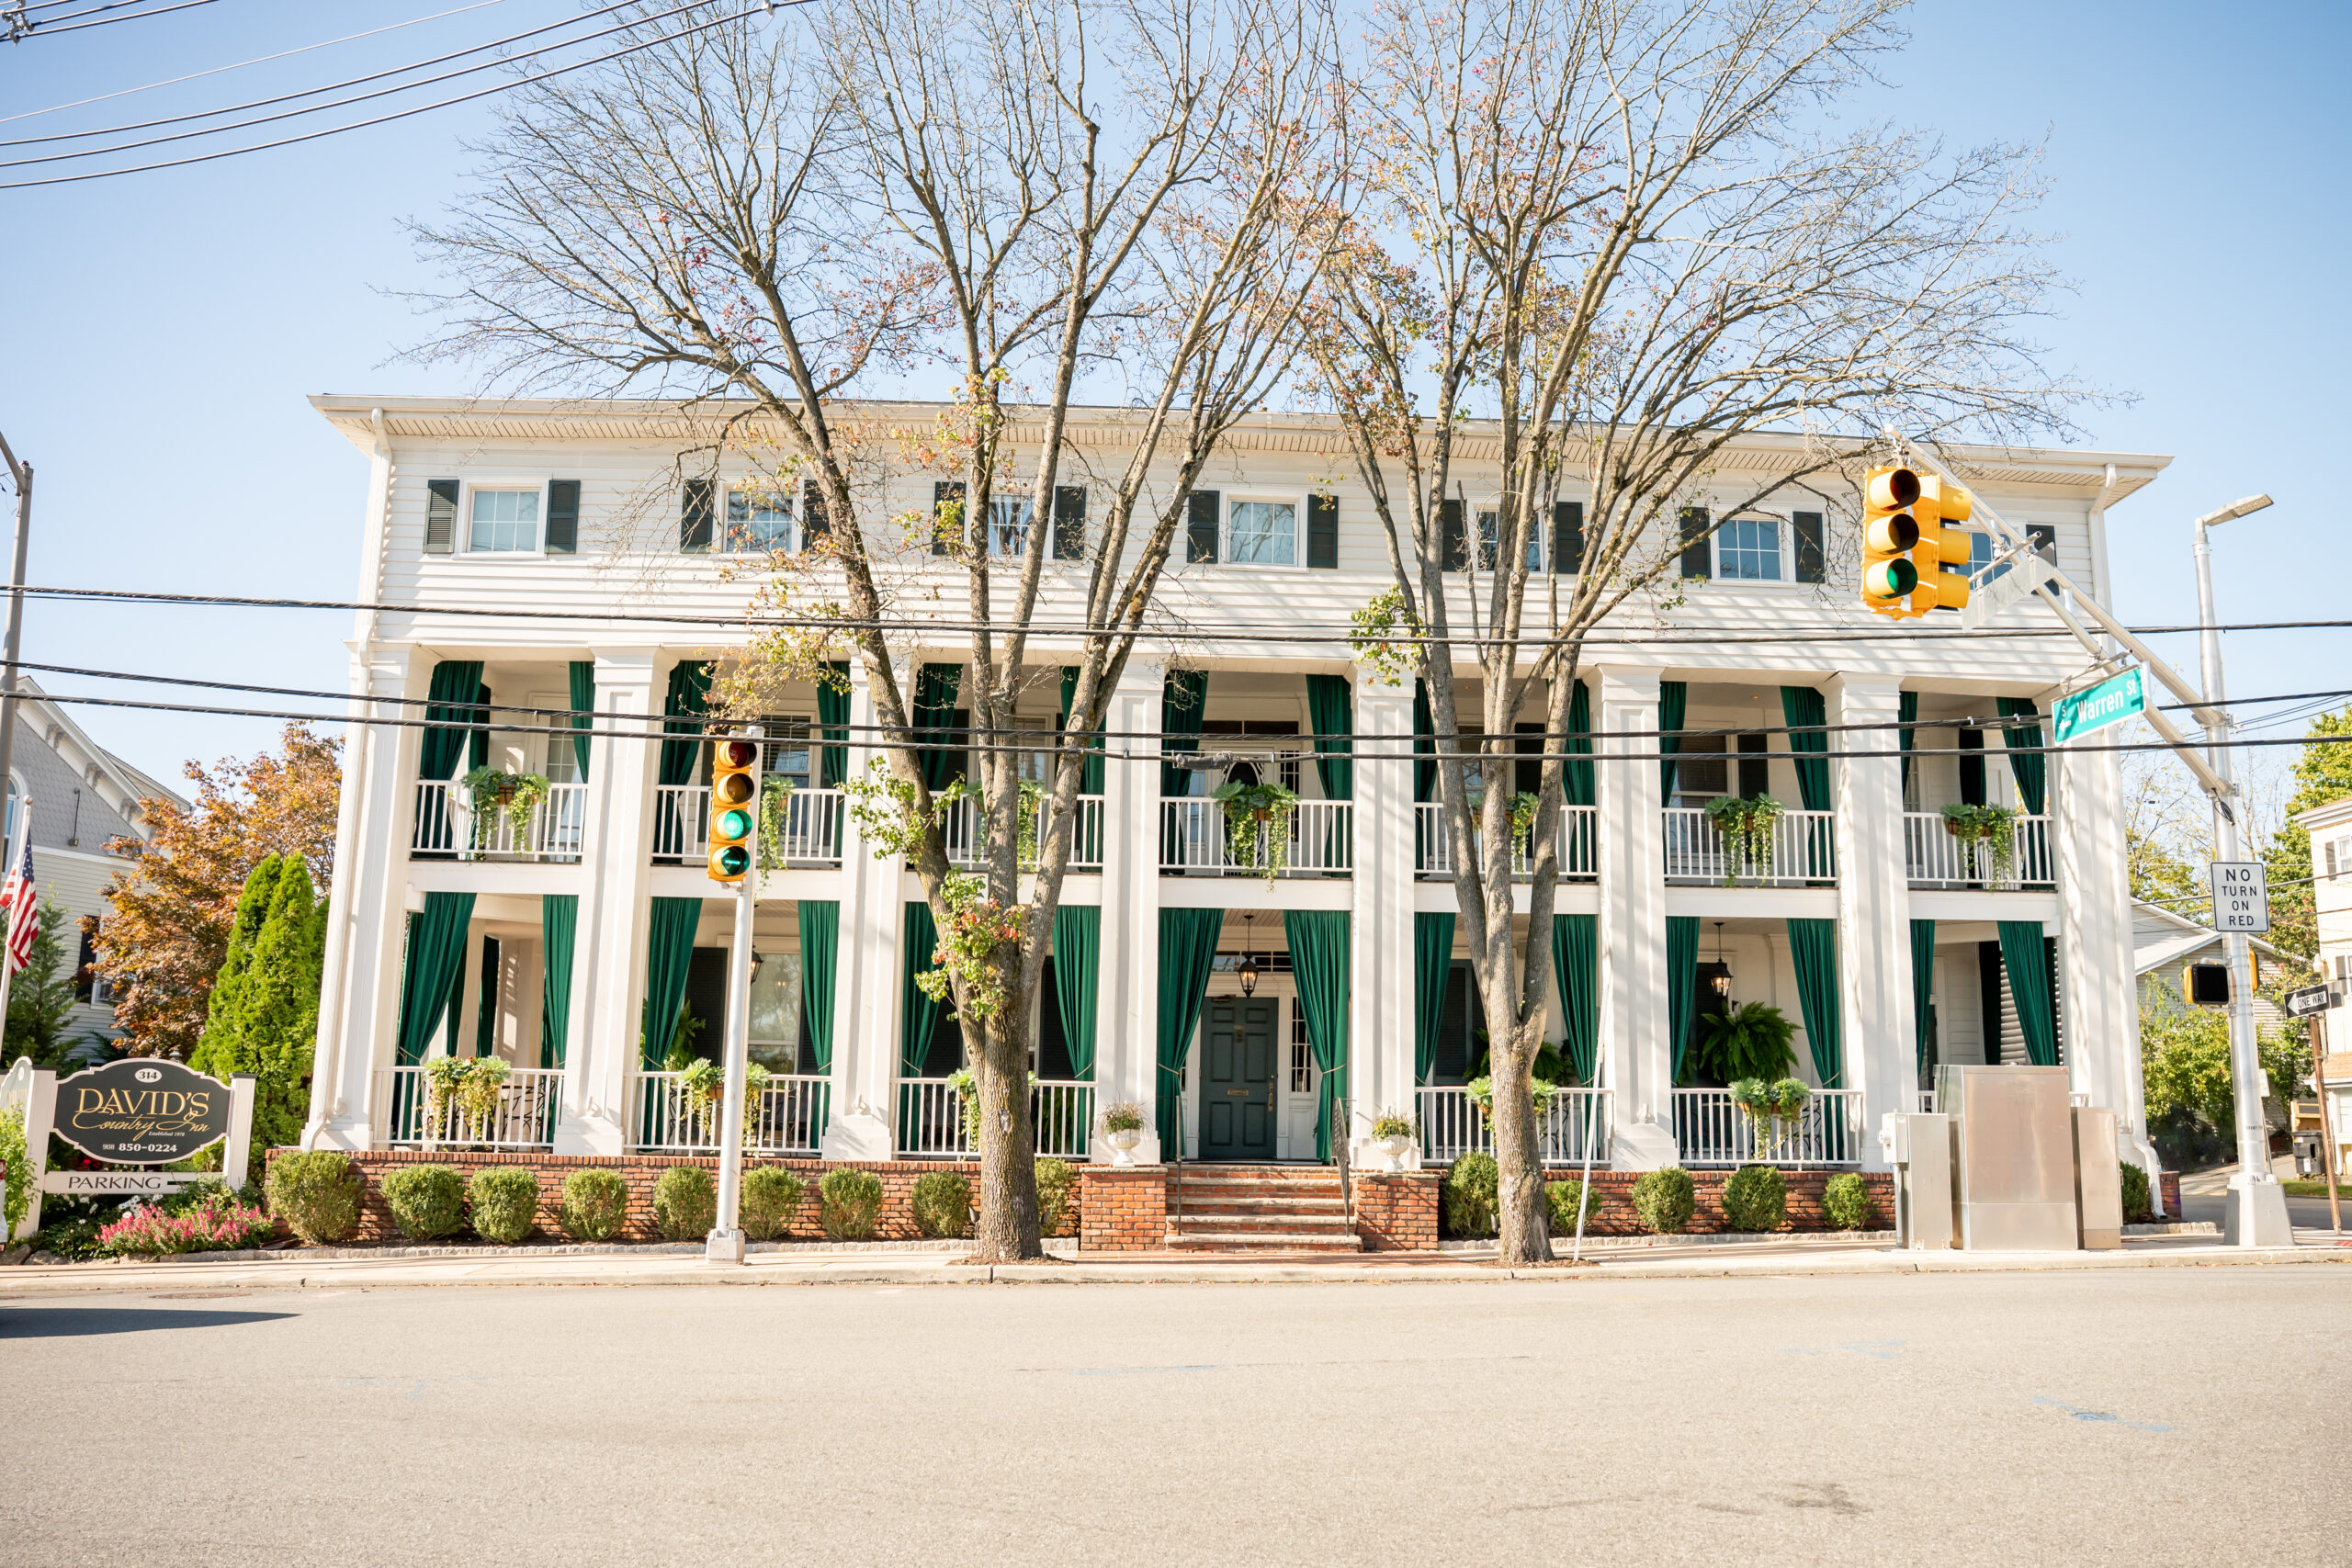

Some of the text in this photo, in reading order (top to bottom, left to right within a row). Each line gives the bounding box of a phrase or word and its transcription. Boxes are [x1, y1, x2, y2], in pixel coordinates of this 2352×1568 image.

[2061, 679, 2137, 724] S Warren St
[2225, 868, 2251, 882] NO
[2221, 886, 2257, 897] TURN
[2232, 900, 2249, 911] ON
[2228, 915, 2255, 926] RED
[2298, 992, 2324, 1009] ONE WAY
[139, 1071, 158, 1079] 314
[74, 1088, 210, 1117] DAVID'S
[72, 1107, 210, 1142] Country Inn
[119, 1143, 177, 1153] 850-0224
[68, 1176, 162, 1190] PARKING
